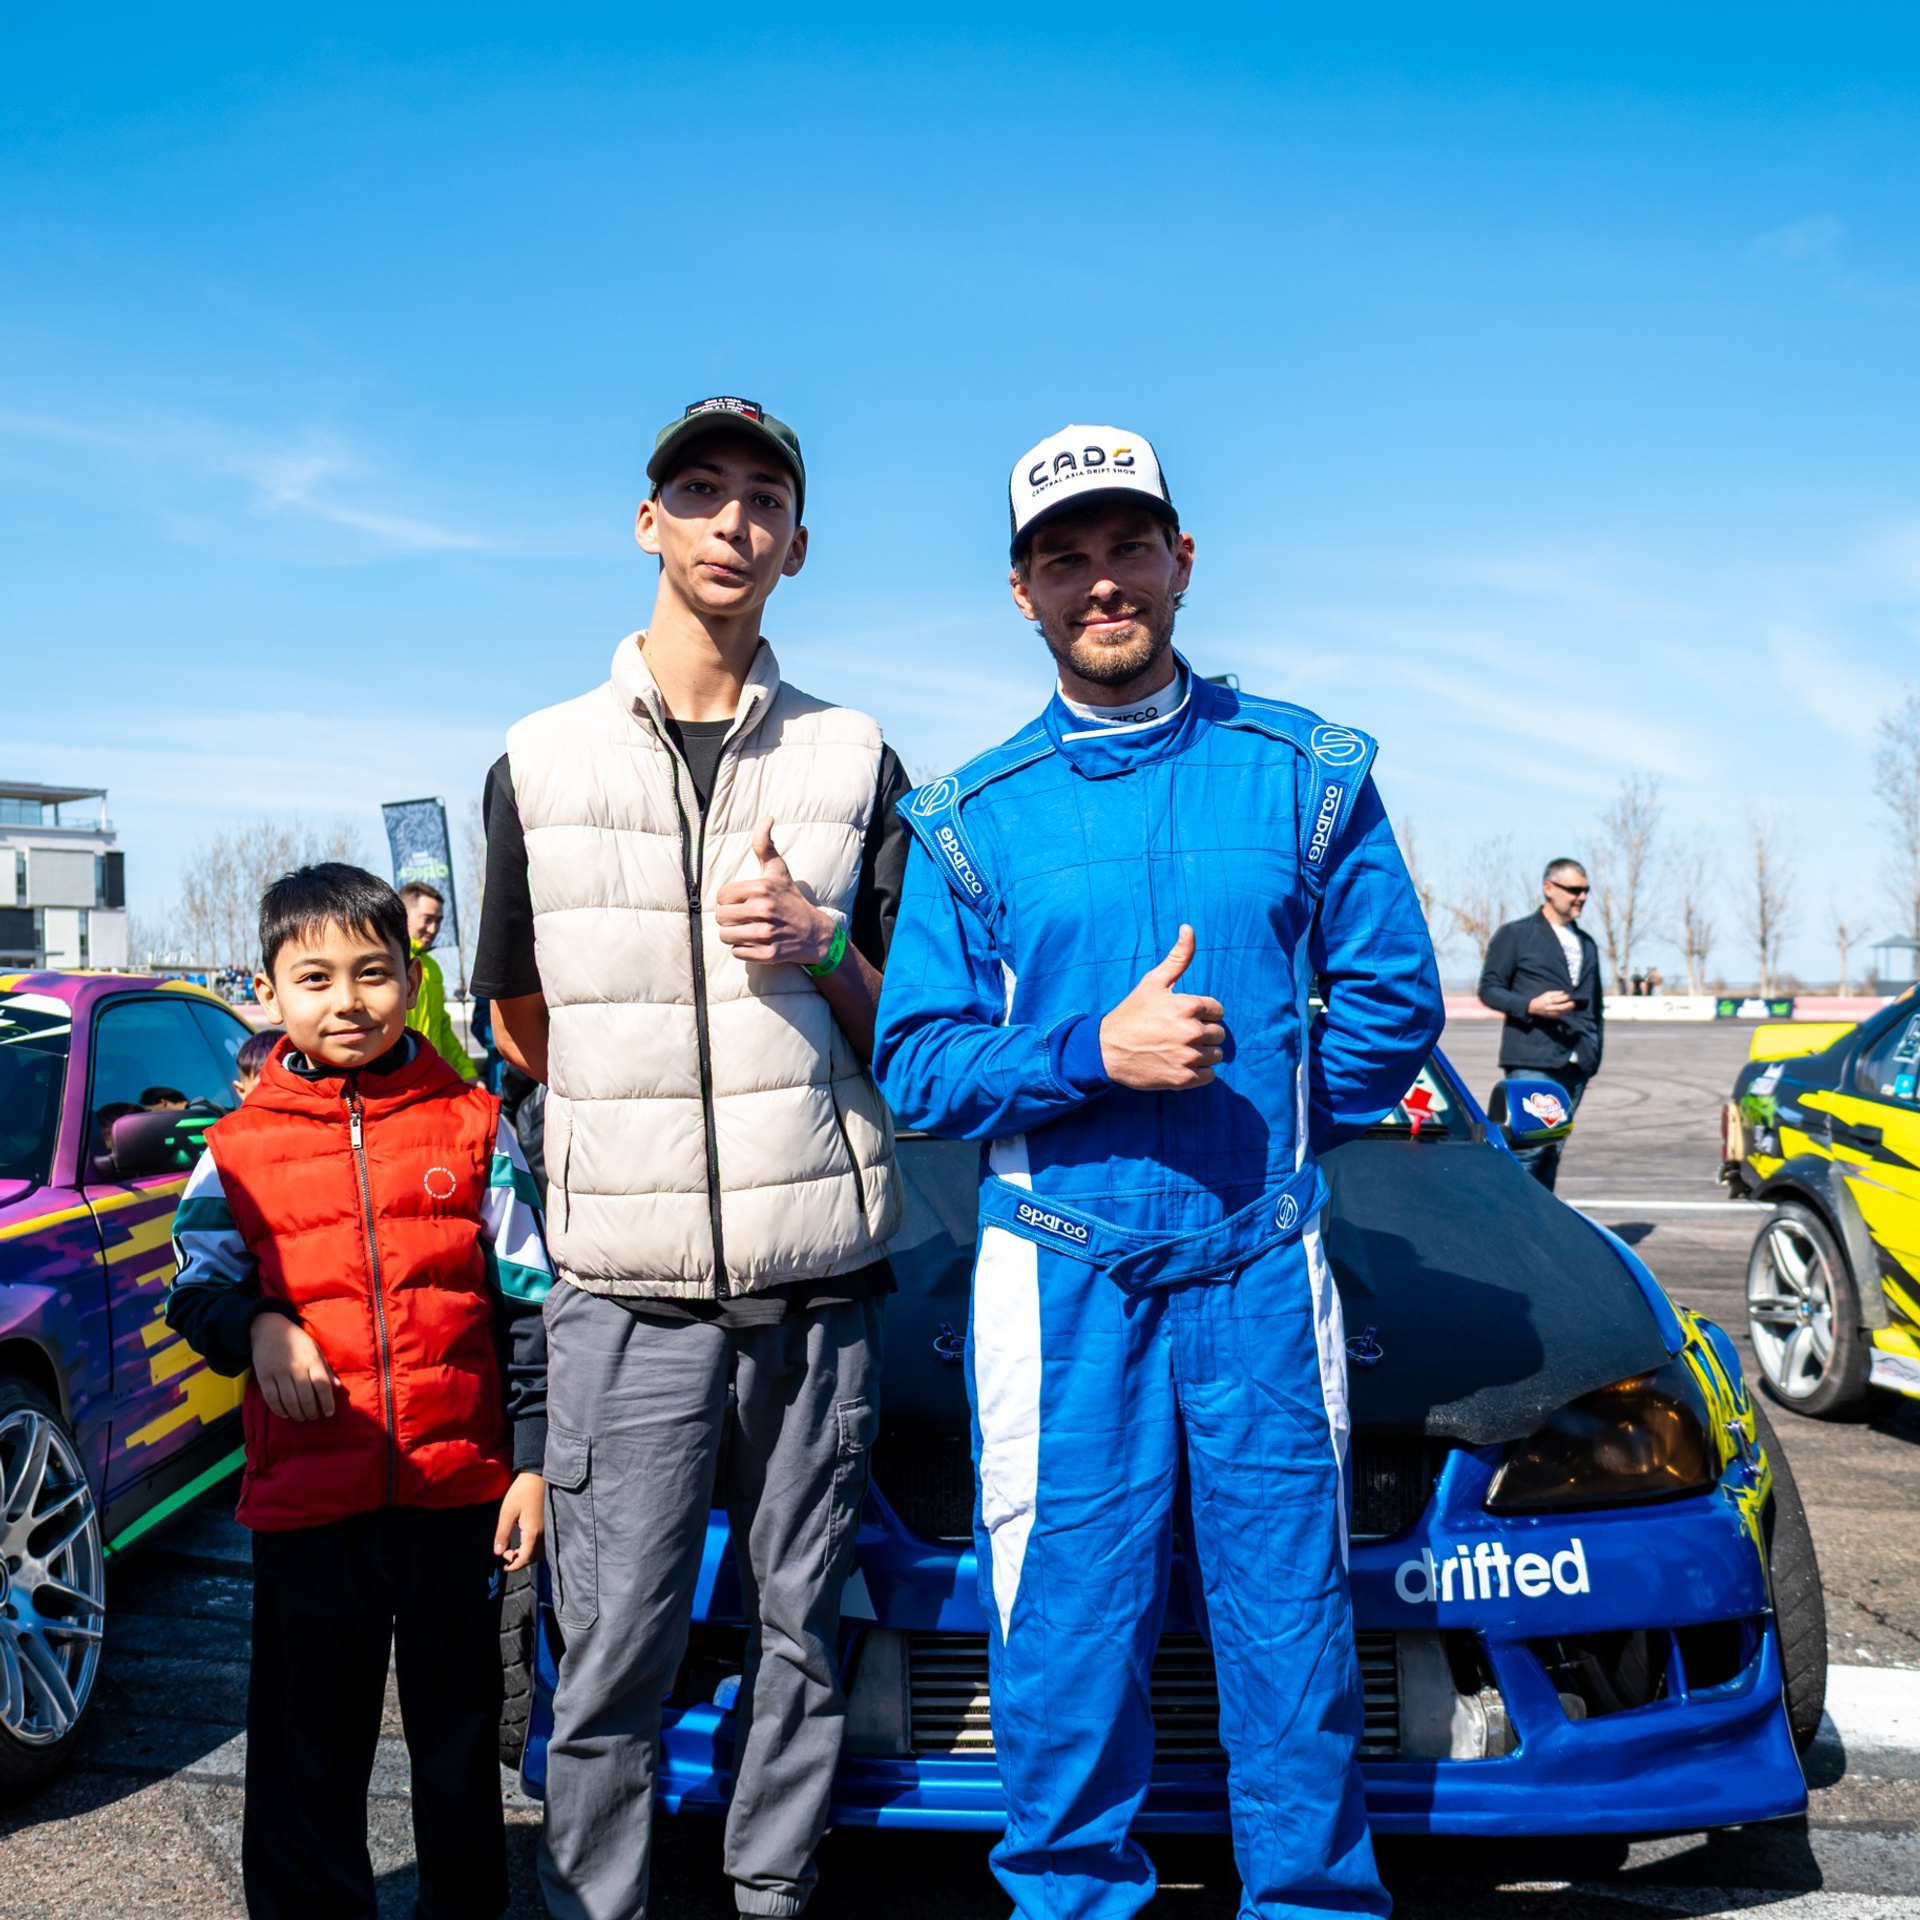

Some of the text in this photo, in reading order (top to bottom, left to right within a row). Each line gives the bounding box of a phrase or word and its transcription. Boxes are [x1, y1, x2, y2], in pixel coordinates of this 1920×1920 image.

[1029, 446, 1135, 487] CADS
[1032, 477, 1063, 497] CENTRAL
[1065, 471, 1084, 480] ASIA
[1308, 785, 1340, 861] sparco
[939, 827, 982, 895] sparco
[1018, 1204, 1087, 1240] sparco
[1394, 1538, 1591, 1604] drifted
